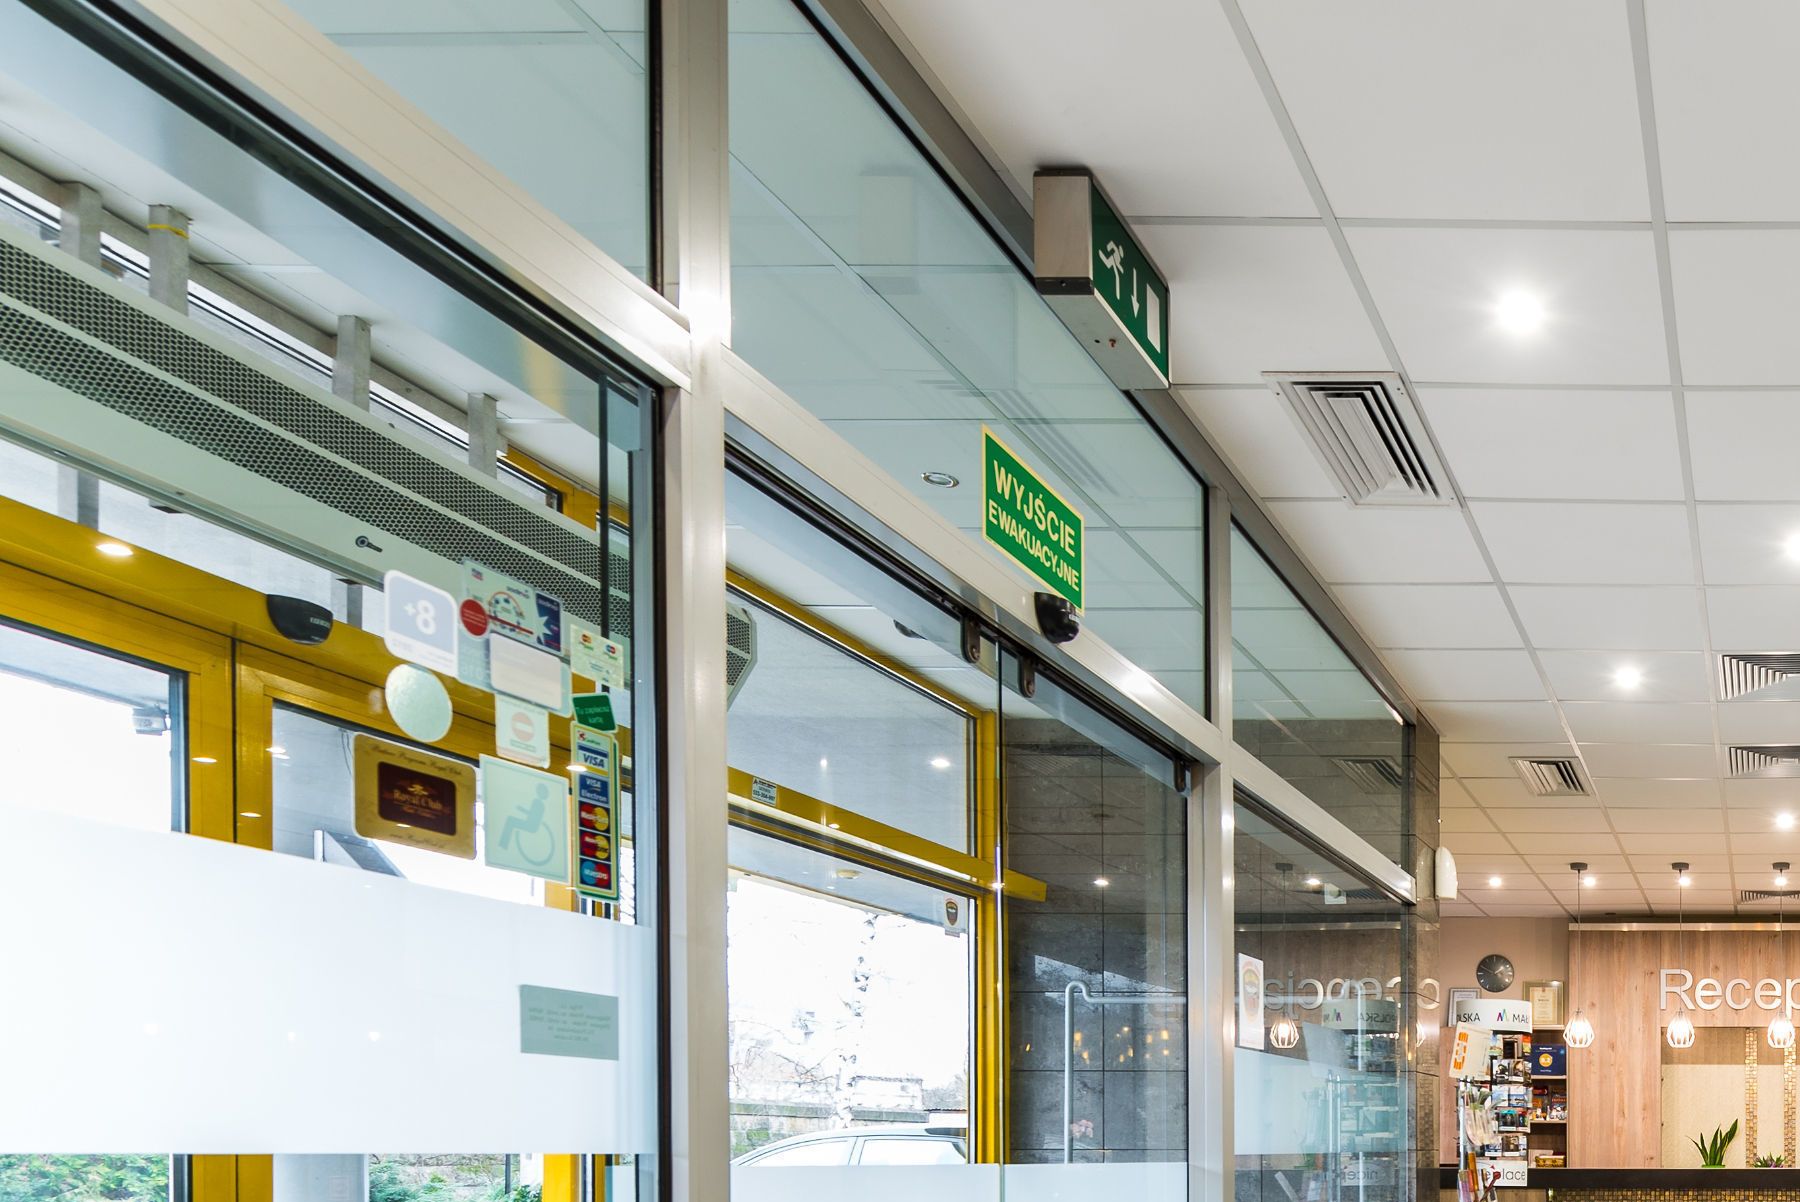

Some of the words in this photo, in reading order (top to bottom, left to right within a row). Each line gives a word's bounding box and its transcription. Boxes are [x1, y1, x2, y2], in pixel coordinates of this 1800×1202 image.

[993, 459, 1075, 557] WYJŚCIE
[988, 498, 1080, 592] EWAKUACYJNE
[583, 753, 605, 768] VISA
[586, 777, 601, 788] VISA
